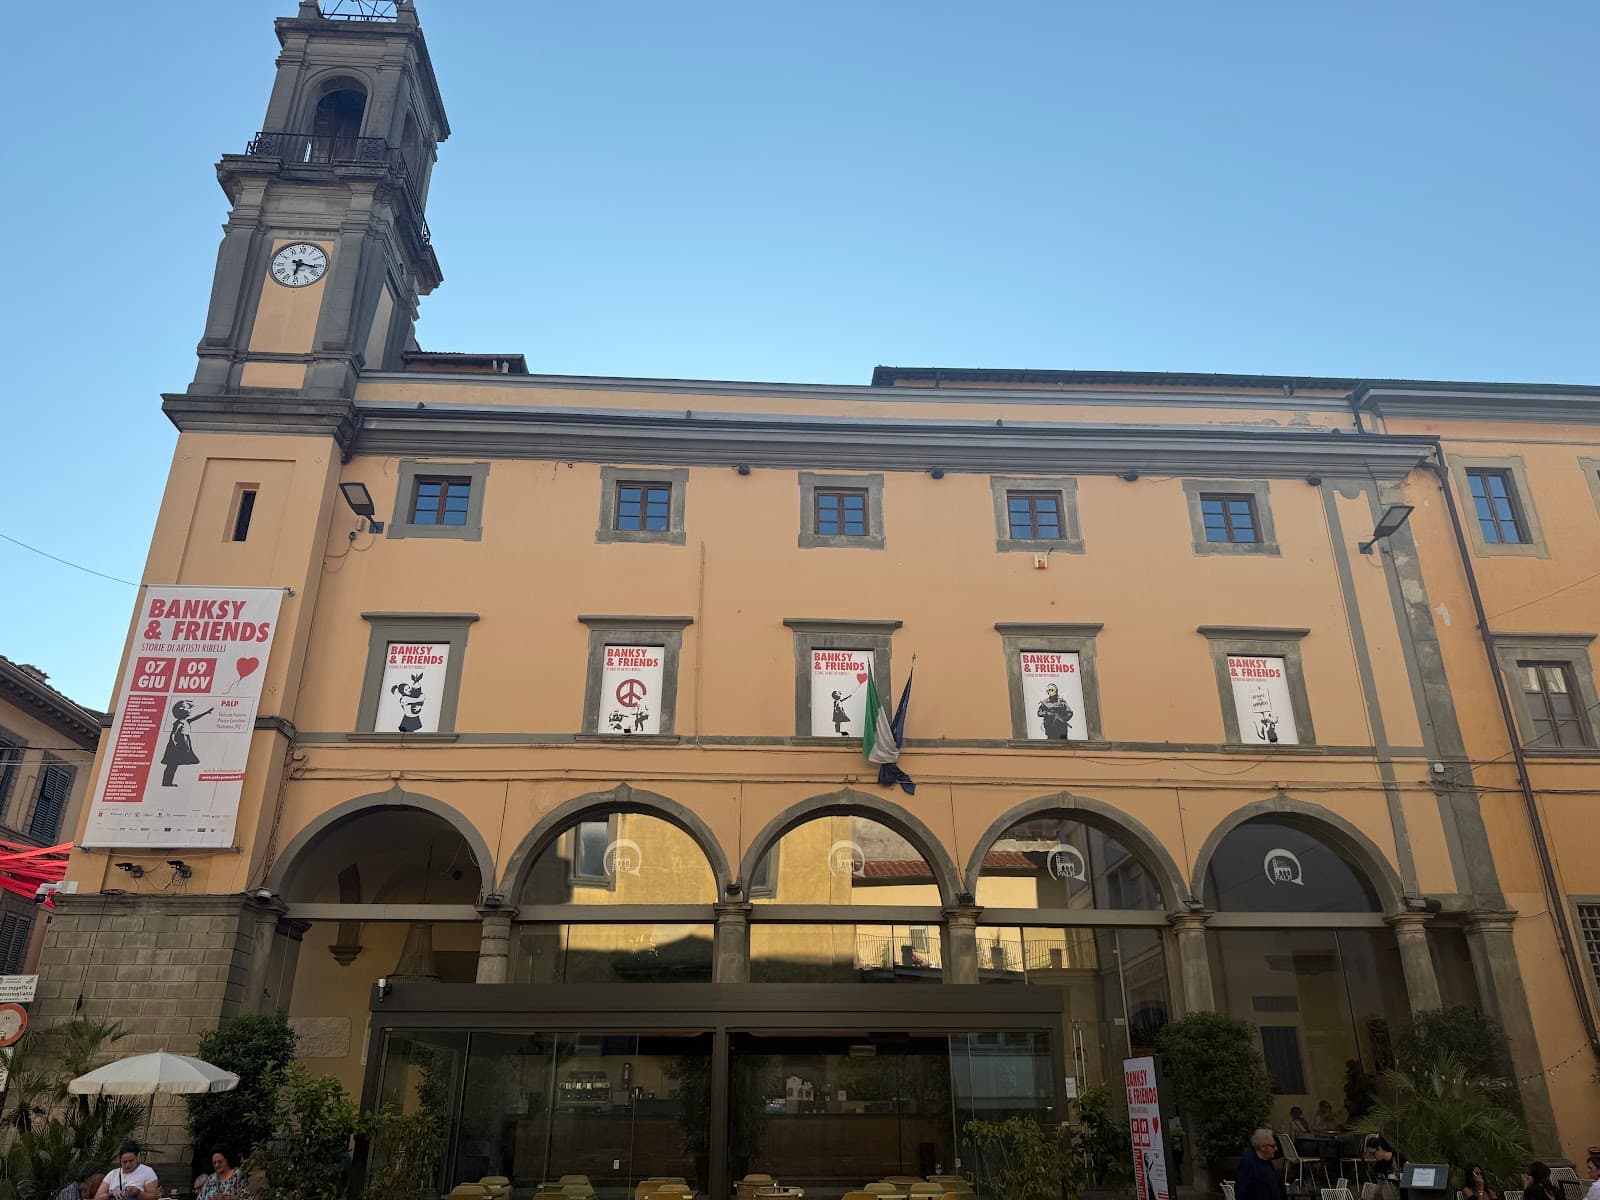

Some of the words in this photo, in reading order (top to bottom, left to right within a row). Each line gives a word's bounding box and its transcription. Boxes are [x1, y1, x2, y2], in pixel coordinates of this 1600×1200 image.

[148, 599, 246, 620] BANKSY
[144, 620, 161, 640] &
[172, 620, 270, 642] FRIENDS
[142, 643, 164, 651] STORIE
[176, 644, 200, 652] ARTISTI
[202, 644, 227, 652] RIBELLI
[391, 646, 432, 655] BANKSY
[608, 649, 647, 658] BANKSY
[814, 652, 852, 661] BANKSY
[390, 656, 396, 664] &
[401, 656, 444, 664] FRIENDS
[606, 658, 614, 666] &
[618, 658, 658, 667] FRIENDS
[1022, 655, 1062, 664] BANKSY
[1229, 659, 1266, 668] BANKSY
[145, 661, 166, 674] 07
[187, 662, 207, 674] 09
[814, 662, 821, 670] &
[826, 662, 864, 670] FRIENDS
[1024, 664, 1031, 672] &
[1035, 664, 1074, 673] FRIENDS
[1231, 668, 1238, 676] &
[1242, 669, 1280, 678] FRIENDS
[138, 676, 166, 688] GIU
[178, 676, 210, 689] NOV
[1126, 1069, 1147, 1087] BANKSY
[1134, 1088, 1157, 1104] FRIENDS
